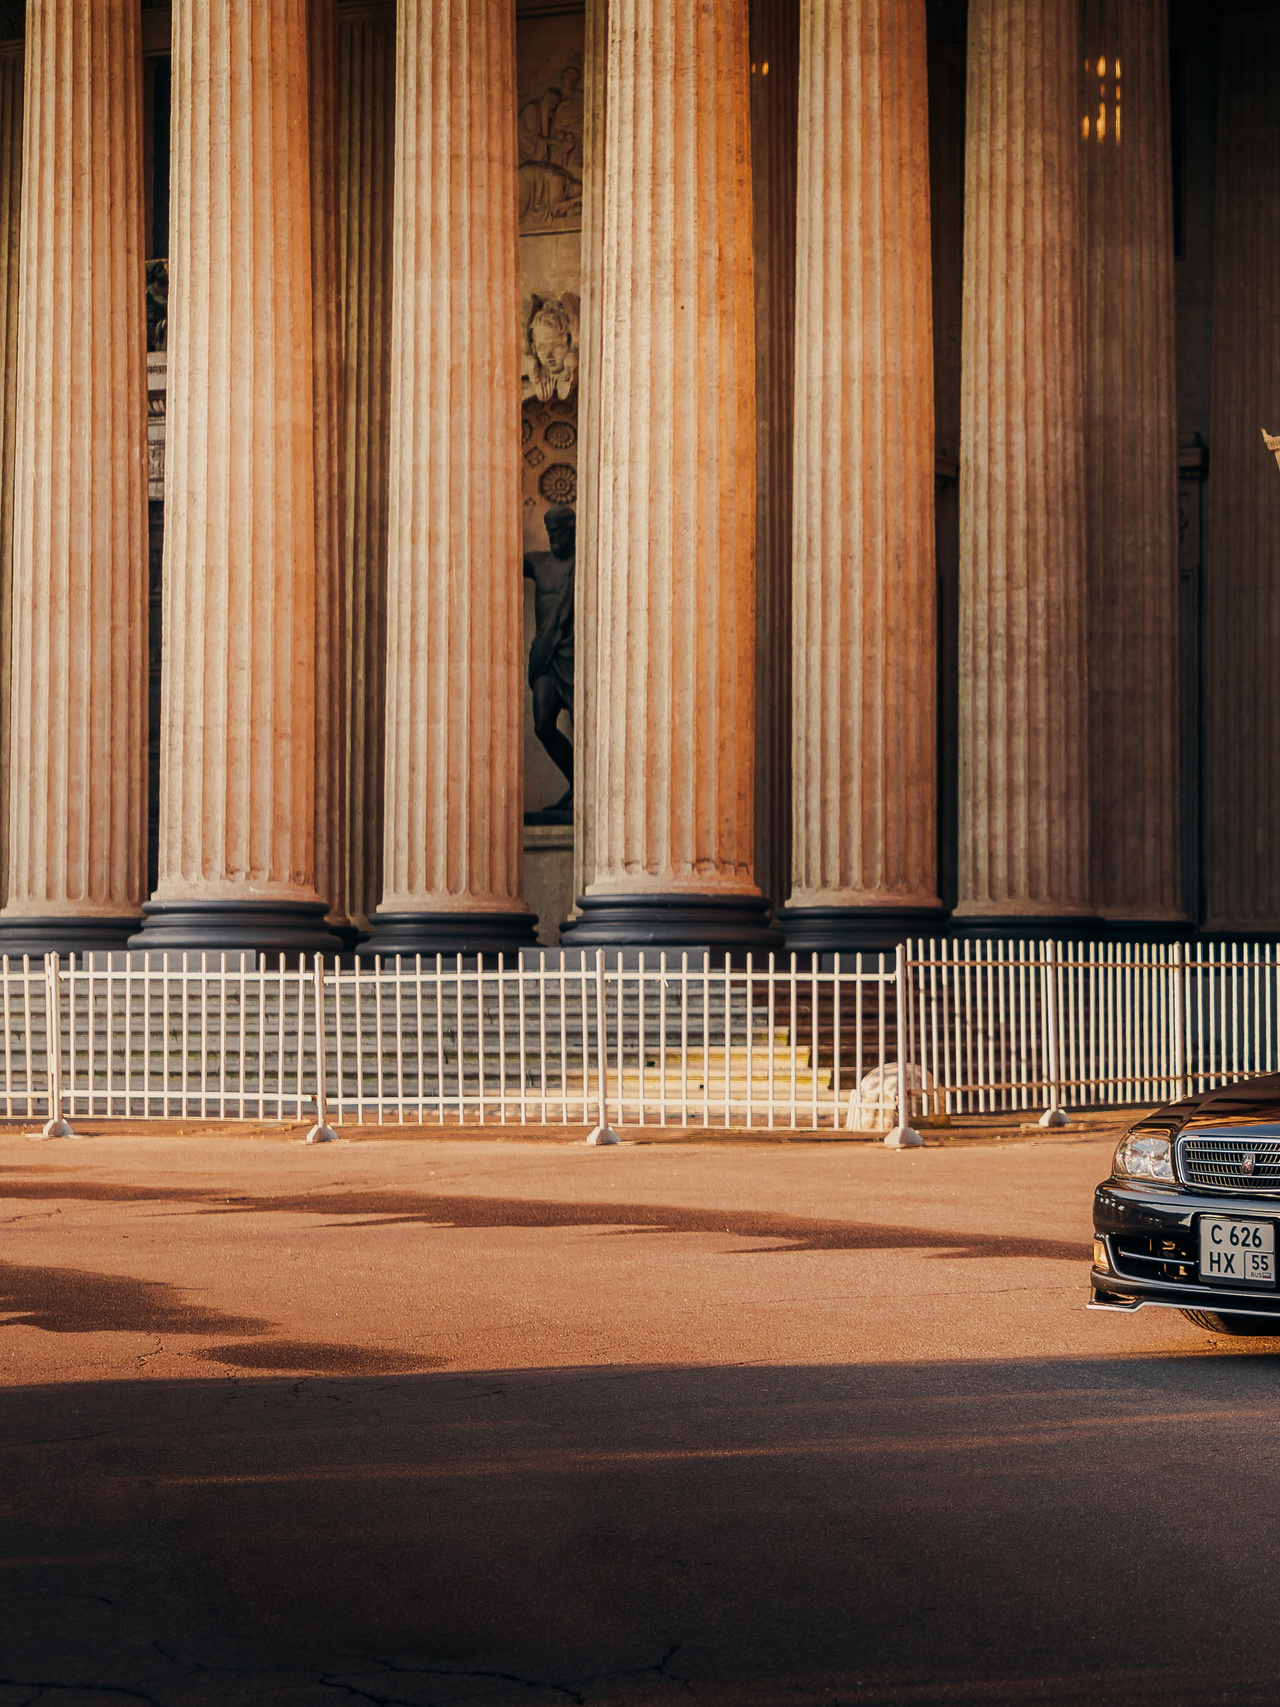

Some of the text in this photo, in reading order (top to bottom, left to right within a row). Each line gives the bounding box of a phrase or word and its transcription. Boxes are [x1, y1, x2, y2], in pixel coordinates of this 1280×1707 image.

[1211, 1224, 1262, 1248] C 626
[1209, 1251, 1235, 1274] HX
[1251, 1254, 1269, 1271] 55
